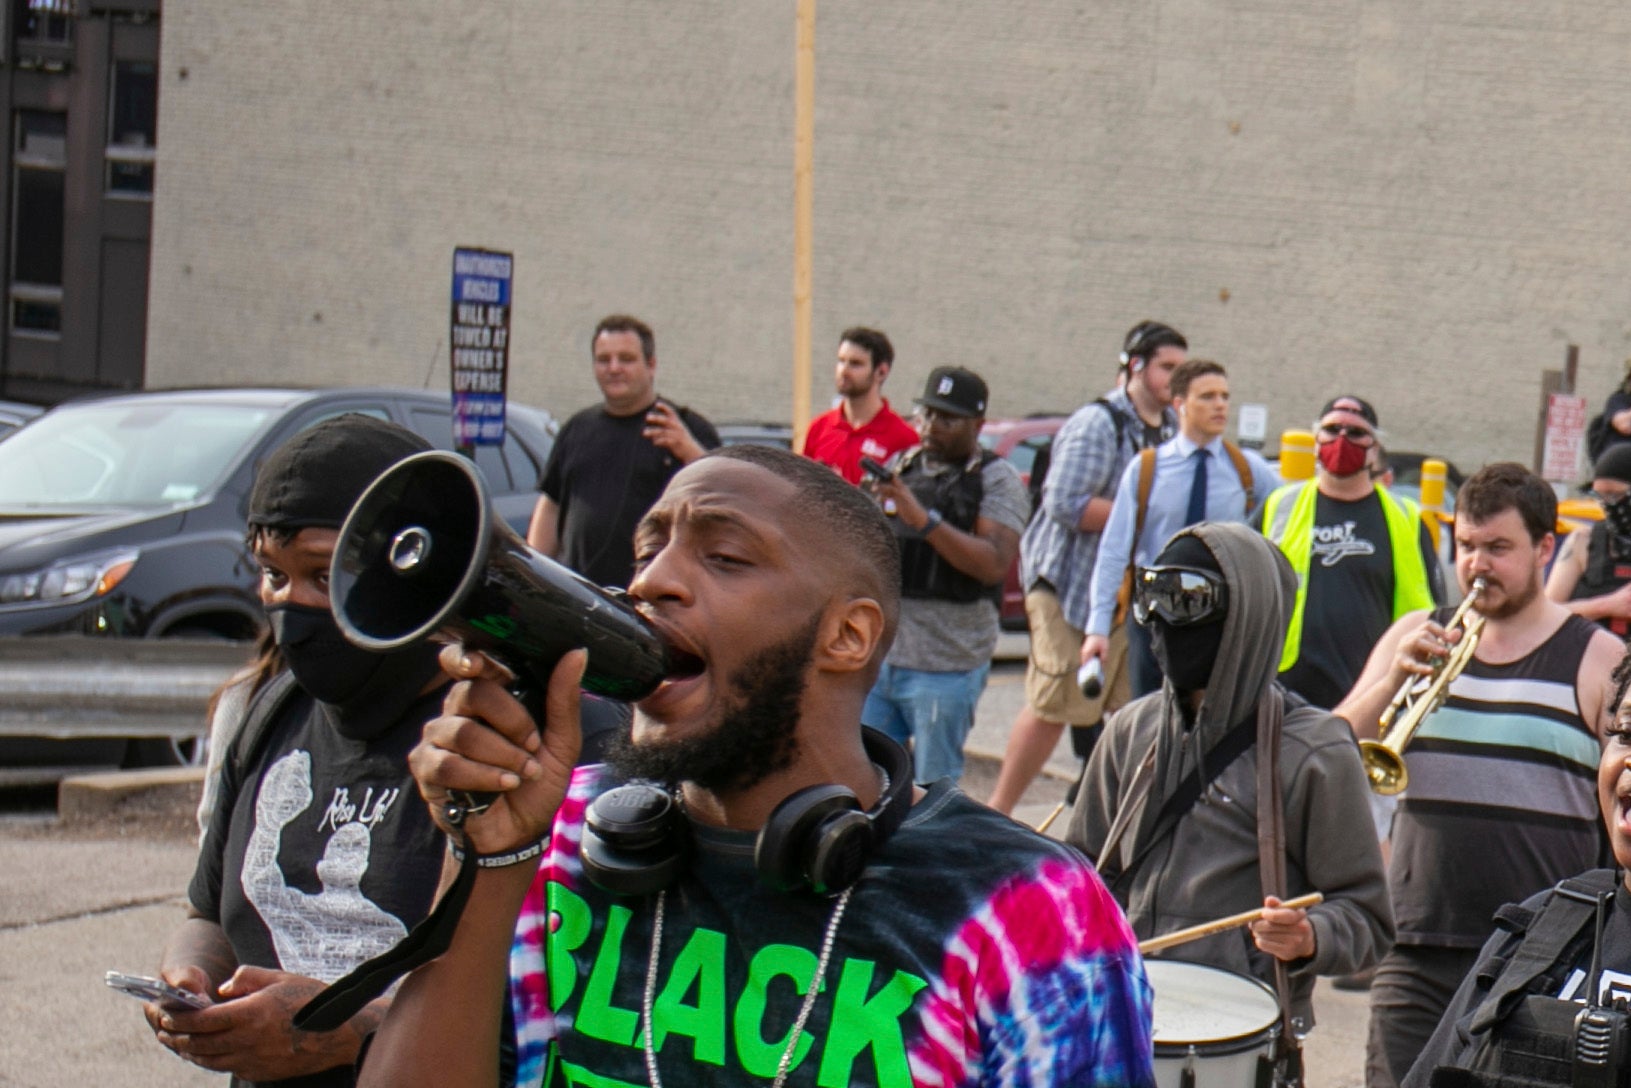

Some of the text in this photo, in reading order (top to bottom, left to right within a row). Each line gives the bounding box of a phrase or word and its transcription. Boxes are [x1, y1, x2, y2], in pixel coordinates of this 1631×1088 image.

[457, 304, 504, 325] WILL BE
[453, 326, 507, 348] TOWED AT
[455, 370, 502, 392] EXPENSE
